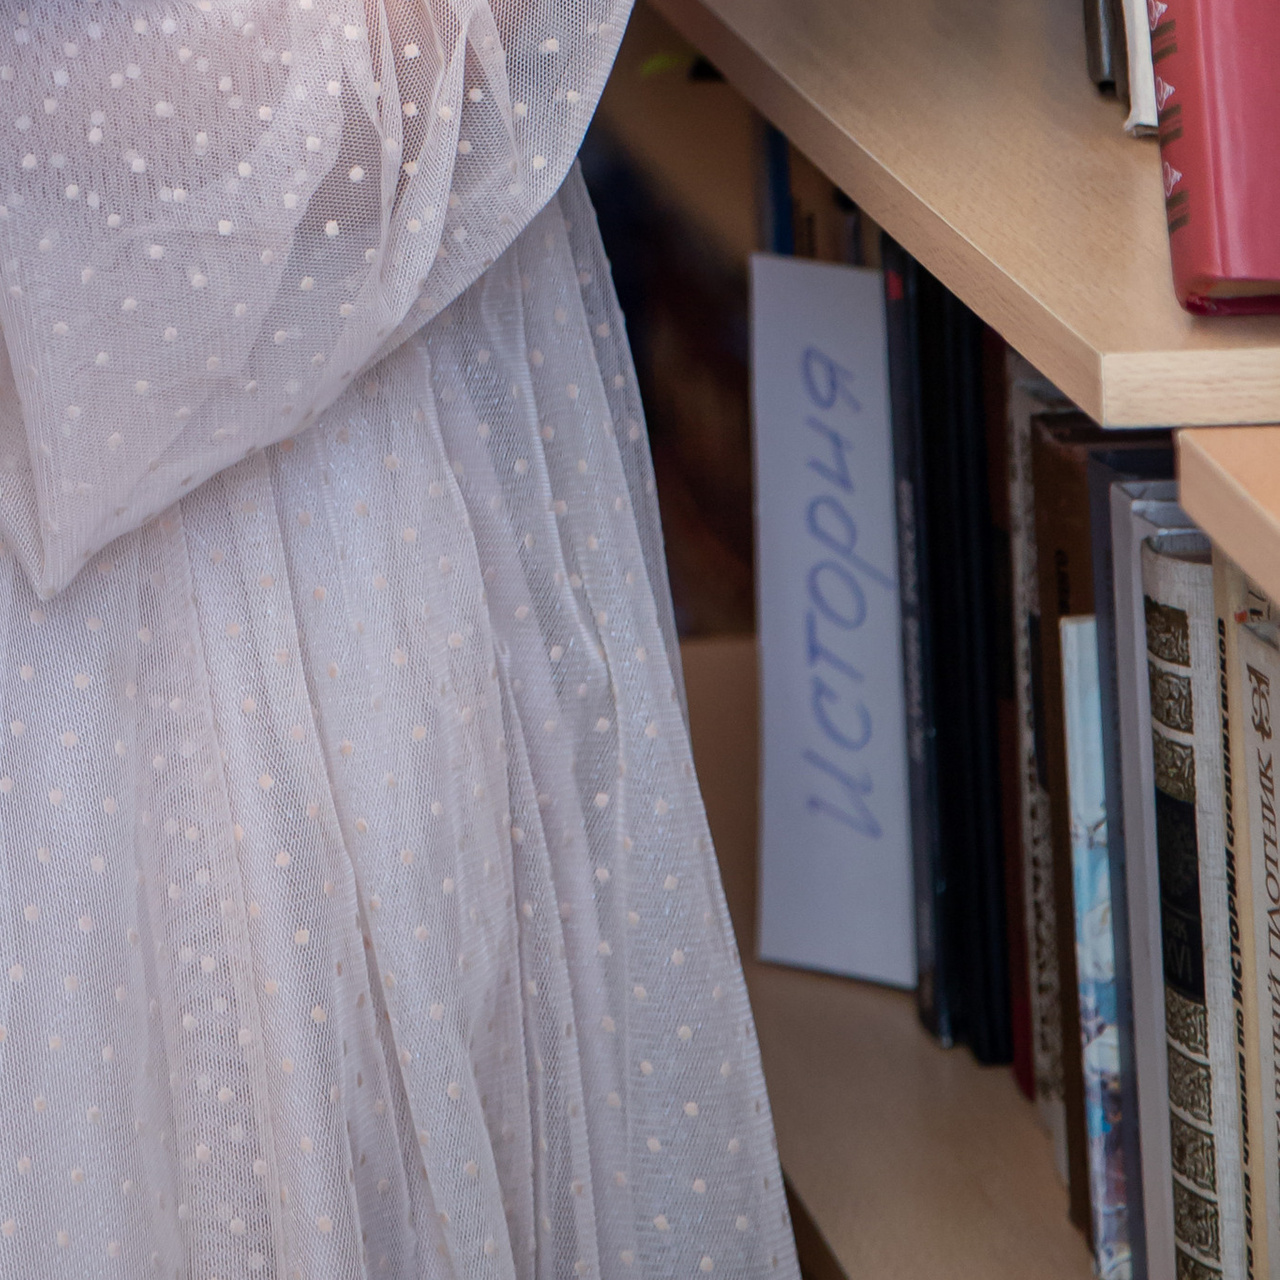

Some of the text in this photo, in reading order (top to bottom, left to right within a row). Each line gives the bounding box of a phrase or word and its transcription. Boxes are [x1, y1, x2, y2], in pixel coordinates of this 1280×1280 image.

[1218, 617, 1231, 711] веков
[1221, 713, 1236, 847] средних
[1257, 746, 1280, 961] ПЛОТНИК
[1225, 847, 1244, 1006] ИСТОРИИ
[1235, 1008, 1246, 1048] по
[1238, 1051, 1250, 1166] чтения
